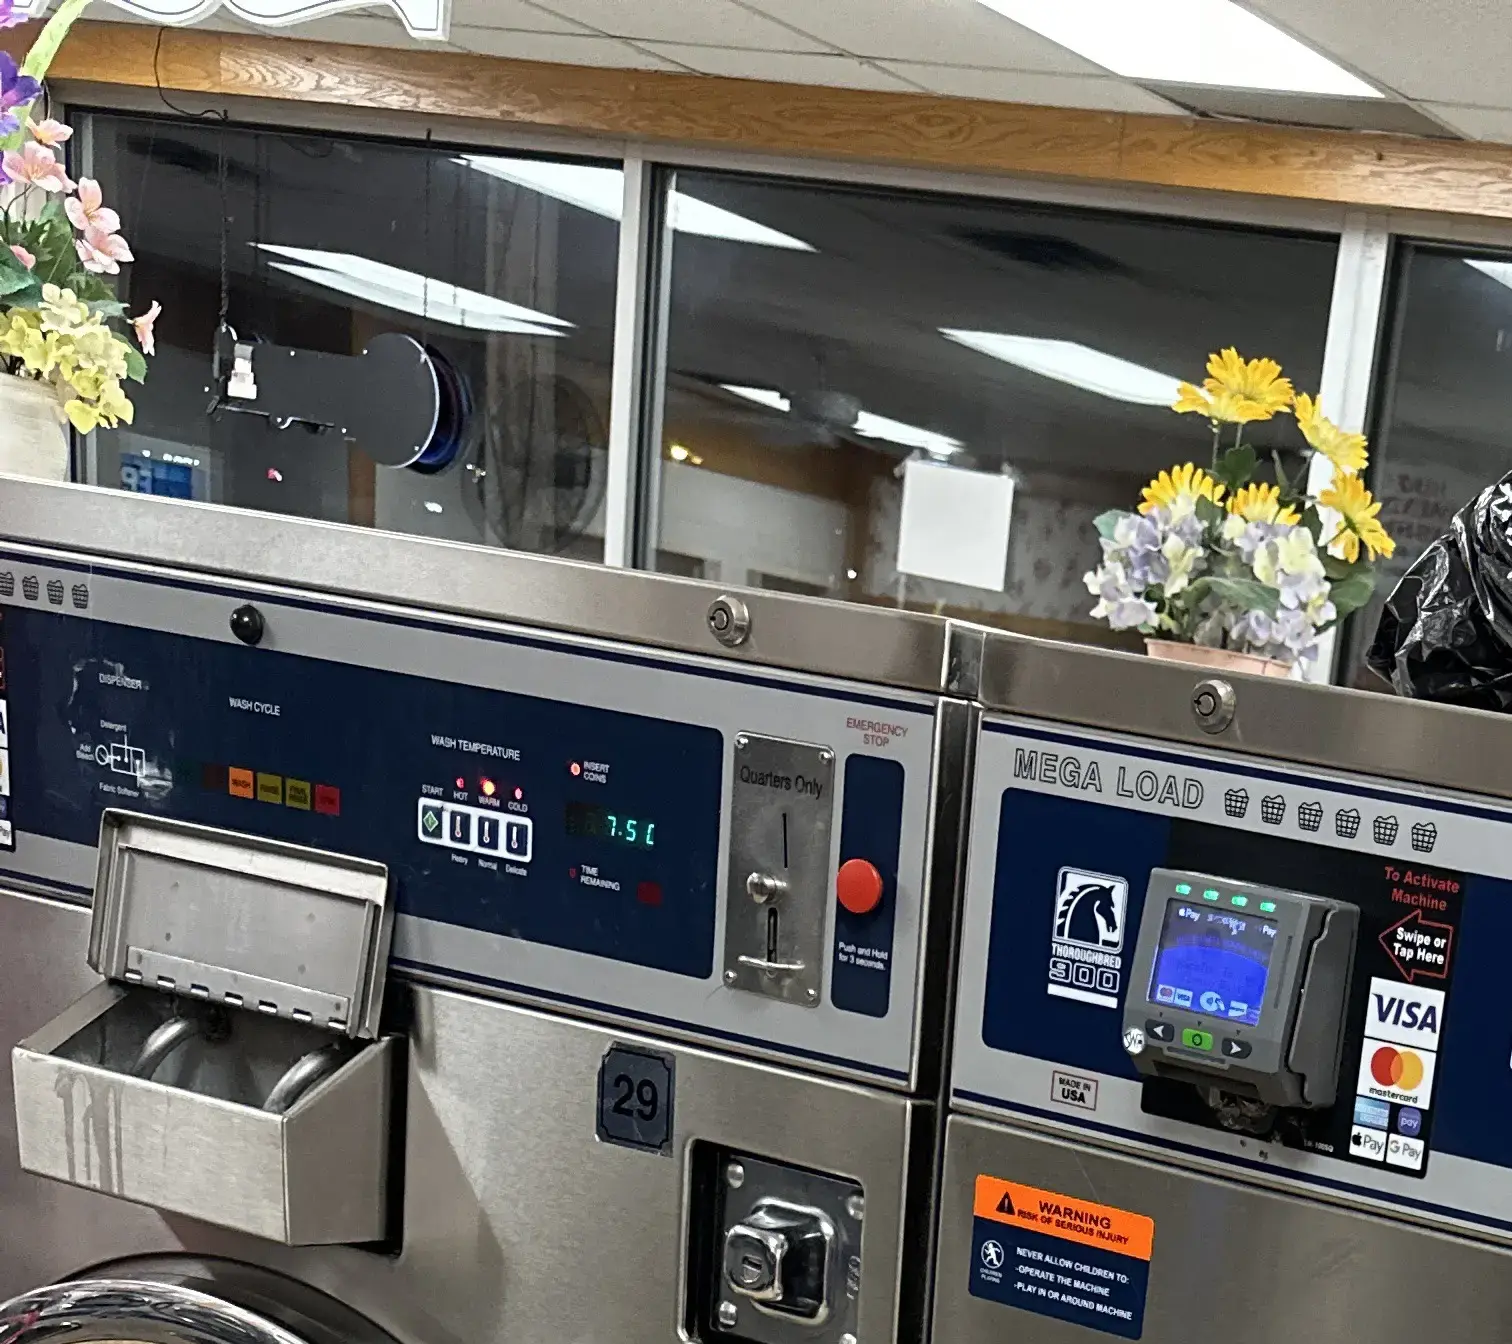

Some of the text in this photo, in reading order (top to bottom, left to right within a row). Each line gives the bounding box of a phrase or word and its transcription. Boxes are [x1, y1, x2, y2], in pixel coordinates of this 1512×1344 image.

[229, 697, 280, 716] WASH CYCLE
[846, 716, 908, 738] EMERGENCY
[431, 734, 521, 761] WASH TEMPERATURE
[863, 733, 890, 748] STOP
[583, 761, 609, 773] INSERT
[583, 771, 607, 784] COINS
[740, 765, 824, 801] Quarters Only
[1013, 747, 1205, 810] MEGA LOAD
[422, 784, 444, 796] START
[453, 791, 468, 801] HOT
[508, 801, 528, 813] COLD
[581, 864, 598, 876] TIME
[1384, 866, 1460, 895] To Activate
[580, 875, 620, 891] REMAINING
[1391, 888, 1448, 912] Machine
[1396, 926, 1446, 950] Swipe or
[1051, 942, 1122, 969] THOROUGHBRED
[1393, 943, 1445, 966] Tap Here
[1048, 959, 1120, 993] 900
[1373, 993, 1438, 1034] VISA
[1058, 1077, 1091, 1091] MADE IN
[613, 1074, 658, 1121] 29
[1061, 1086, 1086, 1105] USA
[1369, 1087, 1418, 1104] mastercard
[1401, 1117, 1419, 1129] pay
[1363, 1134, 1385, 1156] Pay
[1402, 1143, 1422, 1161] Pay
[1039, 1200, 1110, 1229] WARNING
[1017, 1208, 1128, 1244] RISK OF SERIOUS INJURY
[1016, 1246, 1043, 1260] NEVER
[1044, 1254, 1073, 1268] ALLOW
[1074, 1262, 1114, 1280] CHILDREN
[1056, 1274, 1072, 1286] THE
[1073, 1279, 1109, 1296] MACHINE
[1037, 1287, 1046, 1296] IN
[1047, 1290, 1059, 1300] OR
[1060, 1293, 1094, 1309] AROUND
[1095, 1303, 1132, 1320] MACHINE
